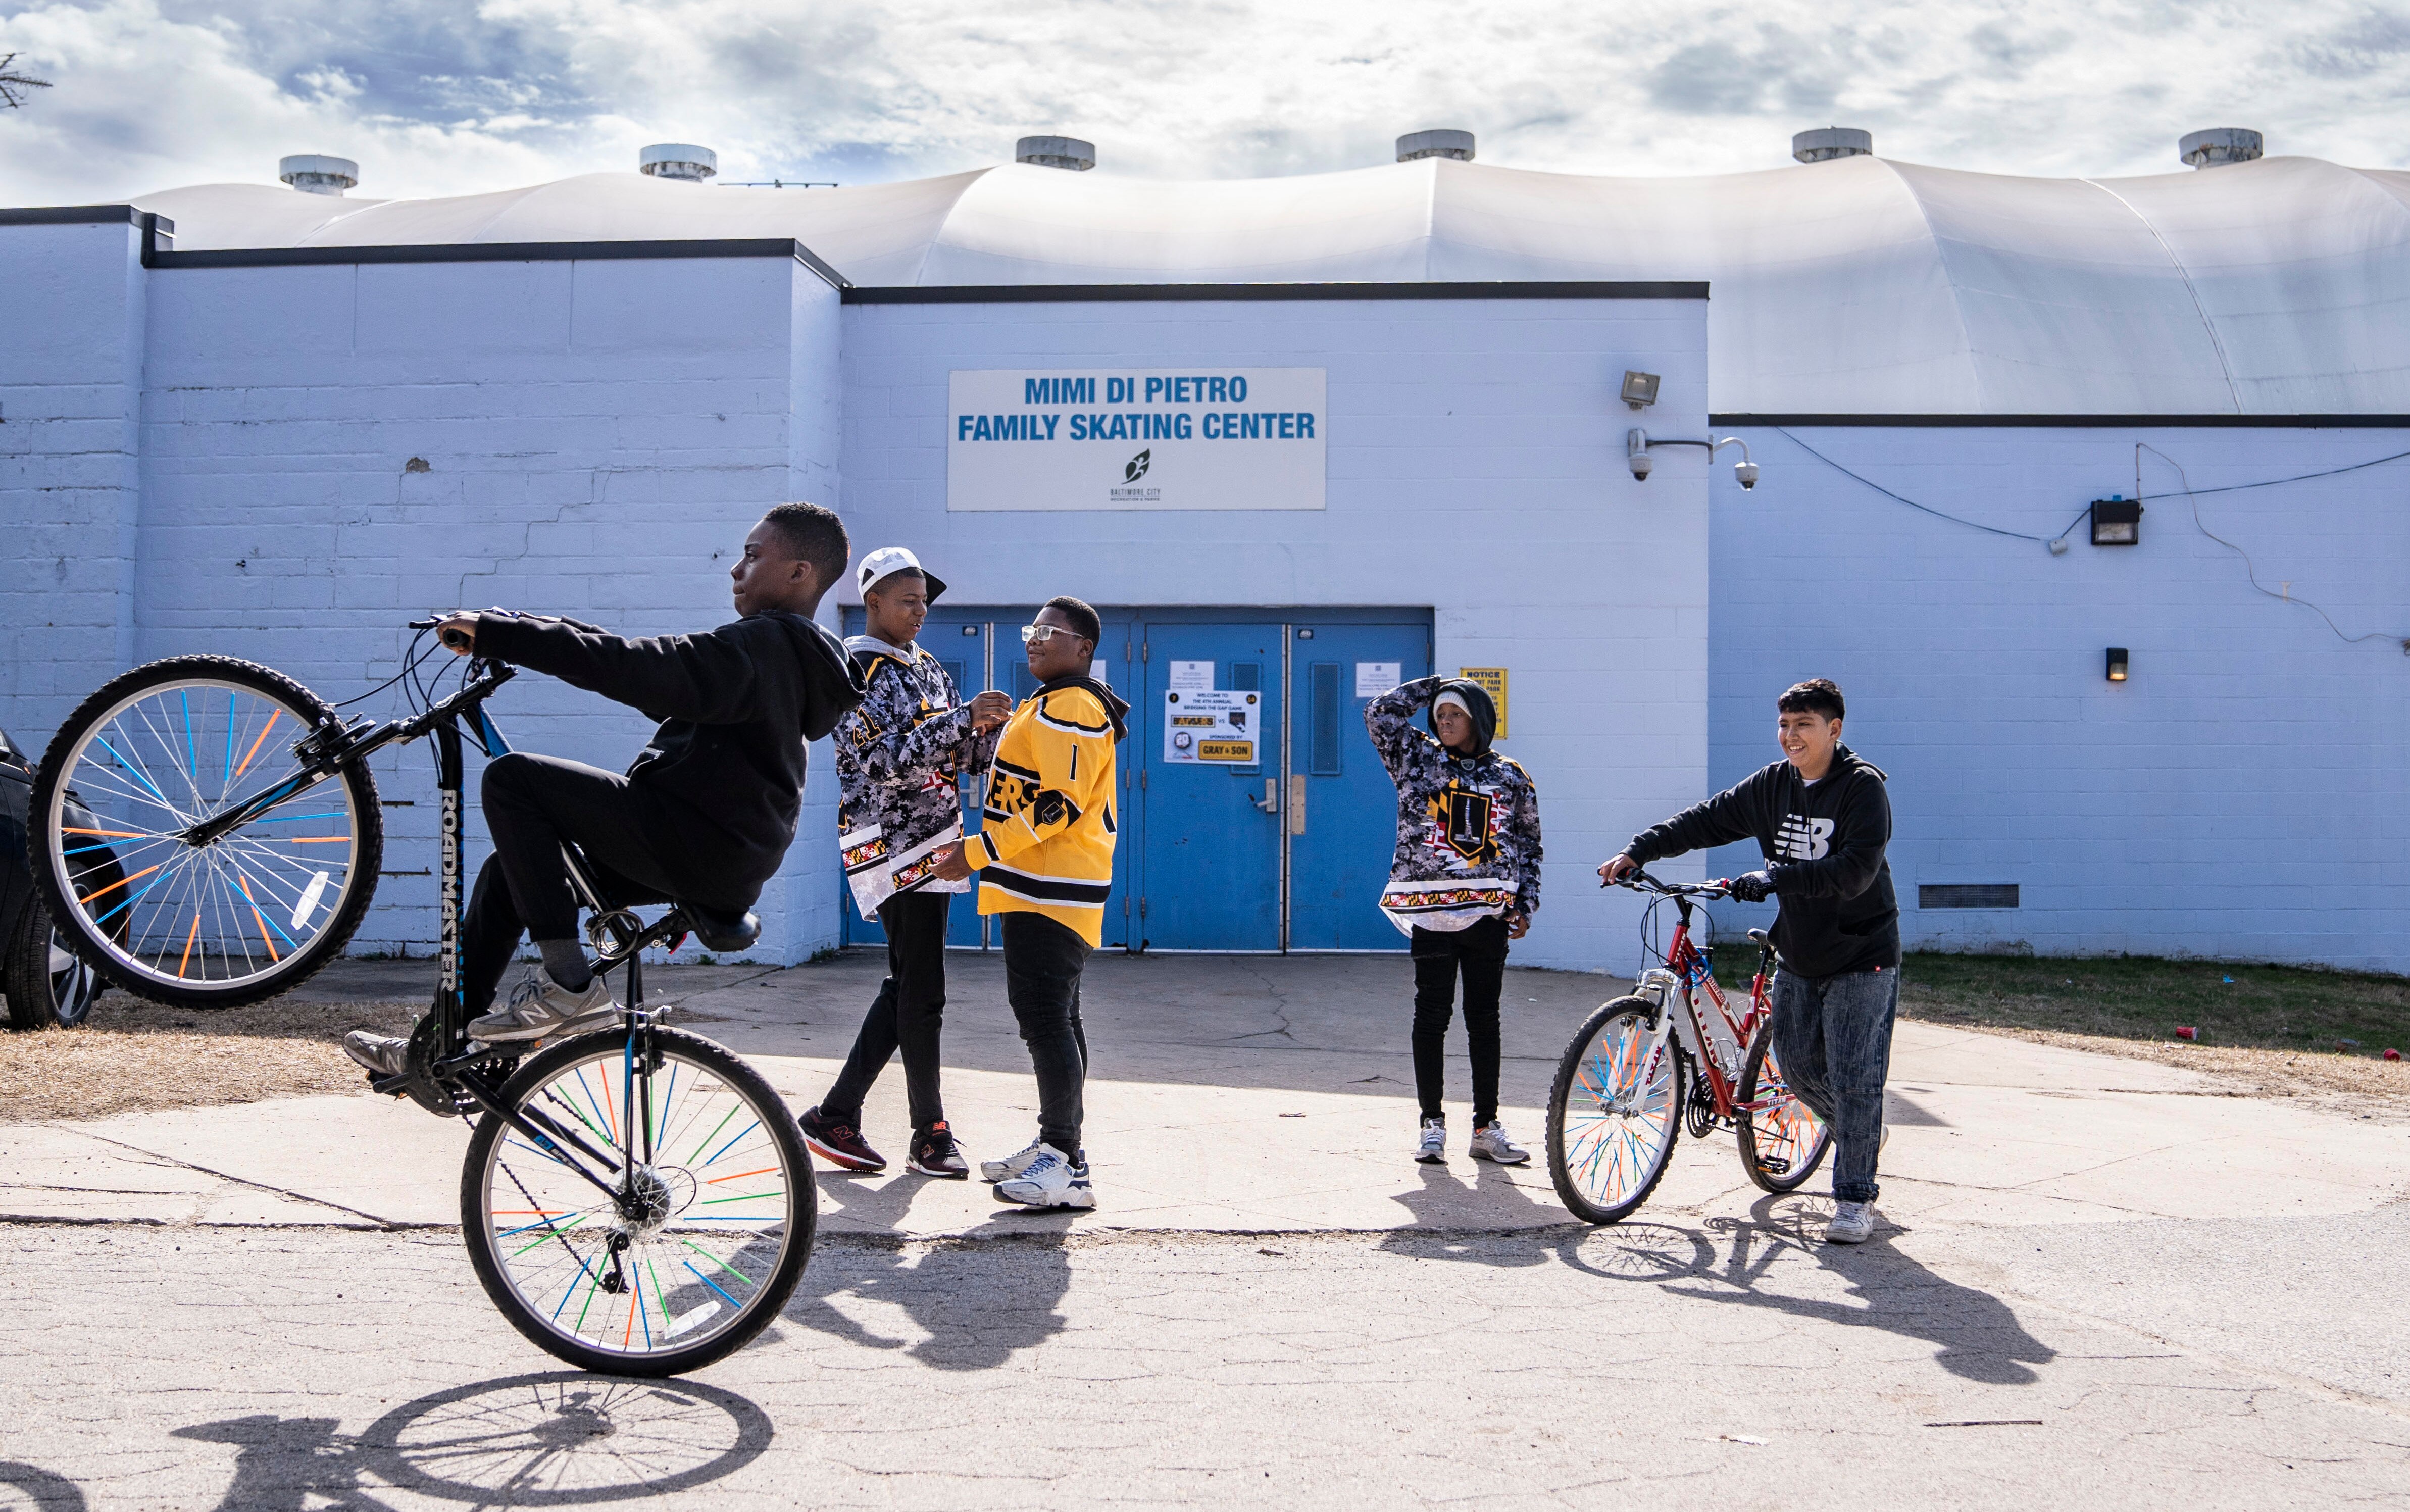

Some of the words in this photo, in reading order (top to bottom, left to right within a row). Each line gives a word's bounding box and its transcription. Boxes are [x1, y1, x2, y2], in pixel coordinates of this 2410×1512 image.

[1025, 378, 1095, 404] MIMI
[1107, 377, 1134, 404] DI
[1145, 376, 1247, 403] PIETRO
[958, 414, 1060, 441] FAMILY
[1070, 413, 1192, 440] SKATING
[1202, 413, 1315, 439] CENTER
[1203, 745, 1223, 754] GRAY
[1231, 746, 1248, 755] SON
[441, 789, 458, 992] ROADMASTER
[1706, 975, 1727, 1004] ATHFIND
[1645, 1045, 1663, 1086] TITAN
[1767, 1097, 1786, 1107] TITAN
